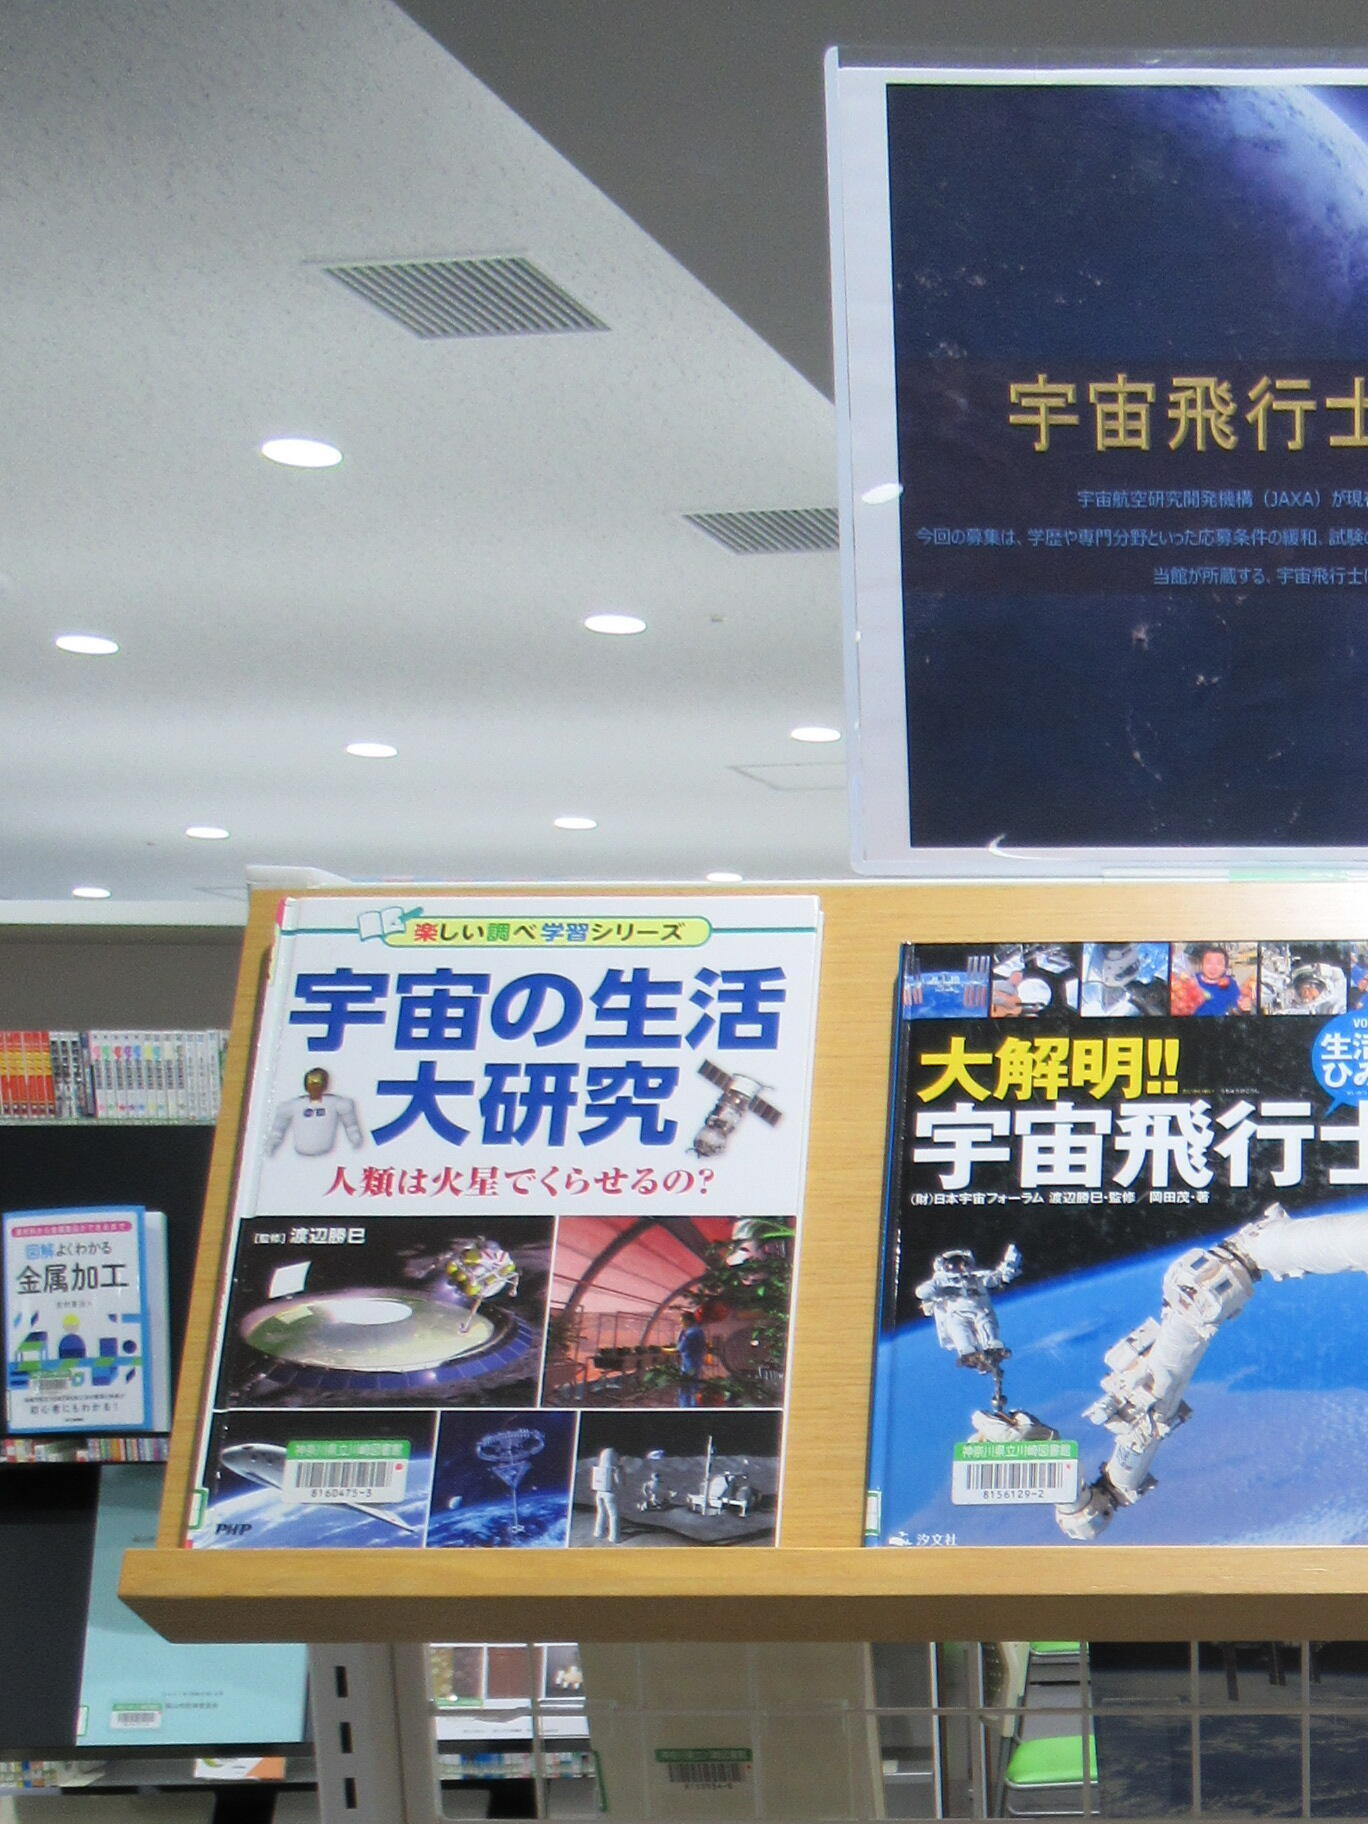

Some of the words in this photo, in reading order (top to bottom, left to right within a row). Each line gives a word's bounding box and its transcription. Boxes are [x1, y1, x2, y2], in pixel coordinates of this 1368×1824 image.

[413, 921, 685, 943] 楽しい調べ学習シリーズ
[289, 966, 787, 1052] 宇宙の生活
[370, 1060, 680, 1147] 大研究
[323, 1166, 715, 1198] 人類は火星でくらせるの?
[17, 1262, 129, 1296] 金属加工
[983, 1489, 1045, 1500] 8156129-2
[215, 1523, 252, 1536] PHP
[916, 1533, 957, 1546] 汐文社
